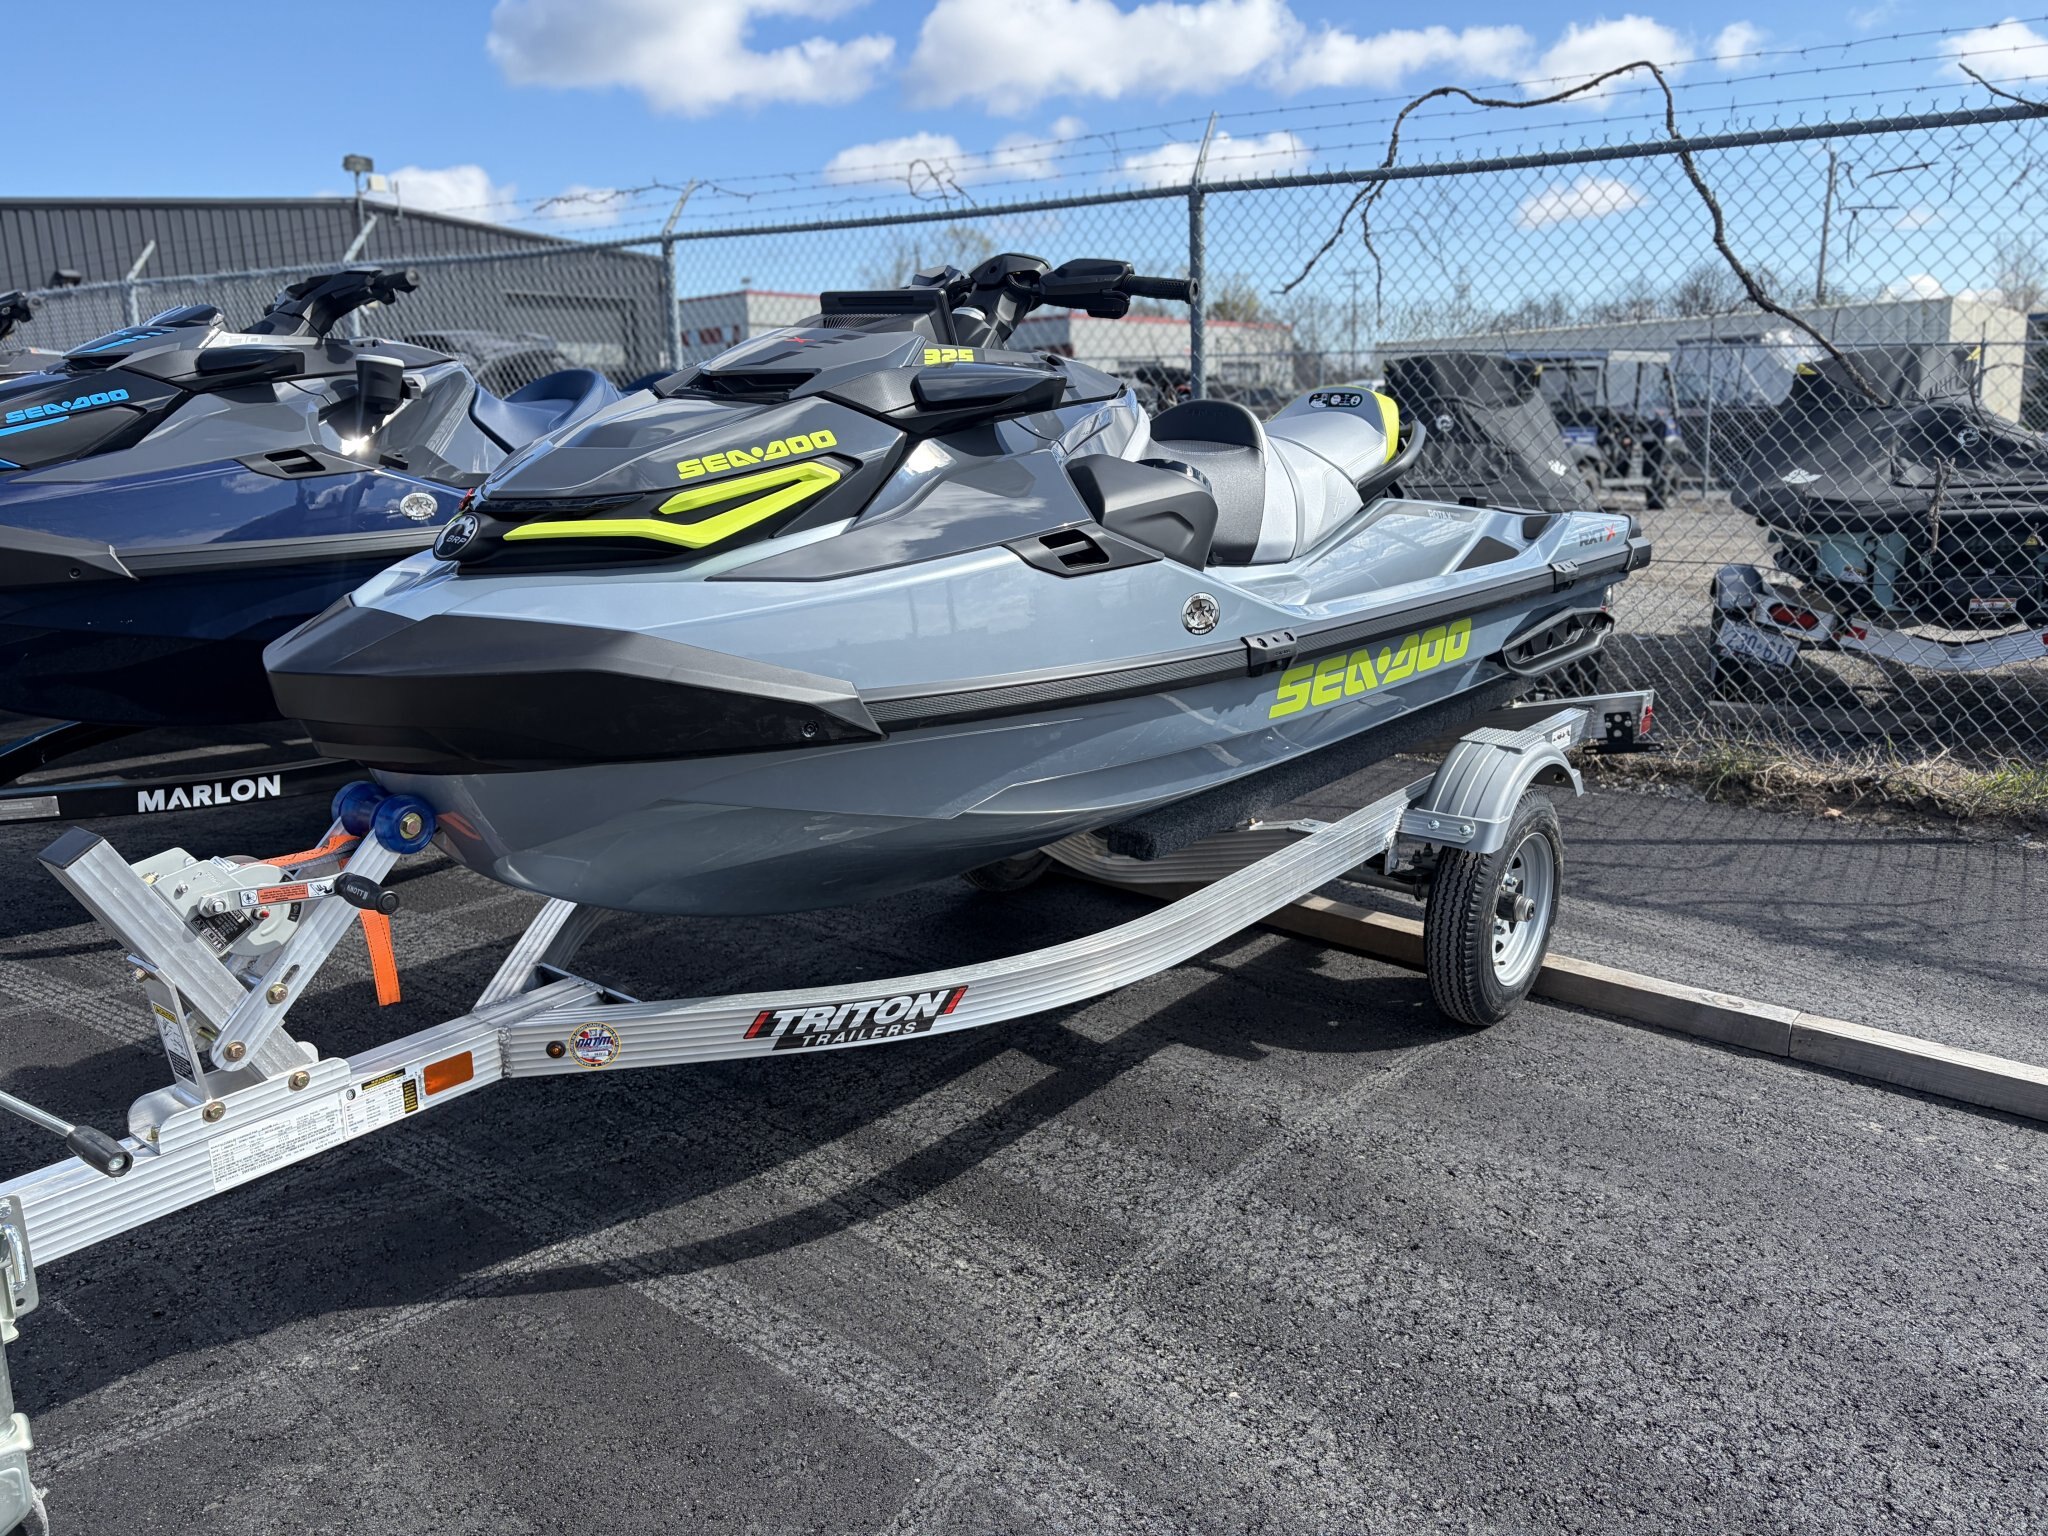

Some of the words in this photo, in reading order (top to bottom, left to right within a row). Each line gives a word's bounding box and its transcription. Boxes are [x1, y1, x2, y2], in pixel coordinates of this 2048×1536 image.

[924, 348, 975, 365] 325
[446, 535, 467, 544] BRP
[137, 774, 281, 813] MARLON
[770, 989, 950, 1037] TRITON
[801, 1021, 916, 1047] TRAILERS
